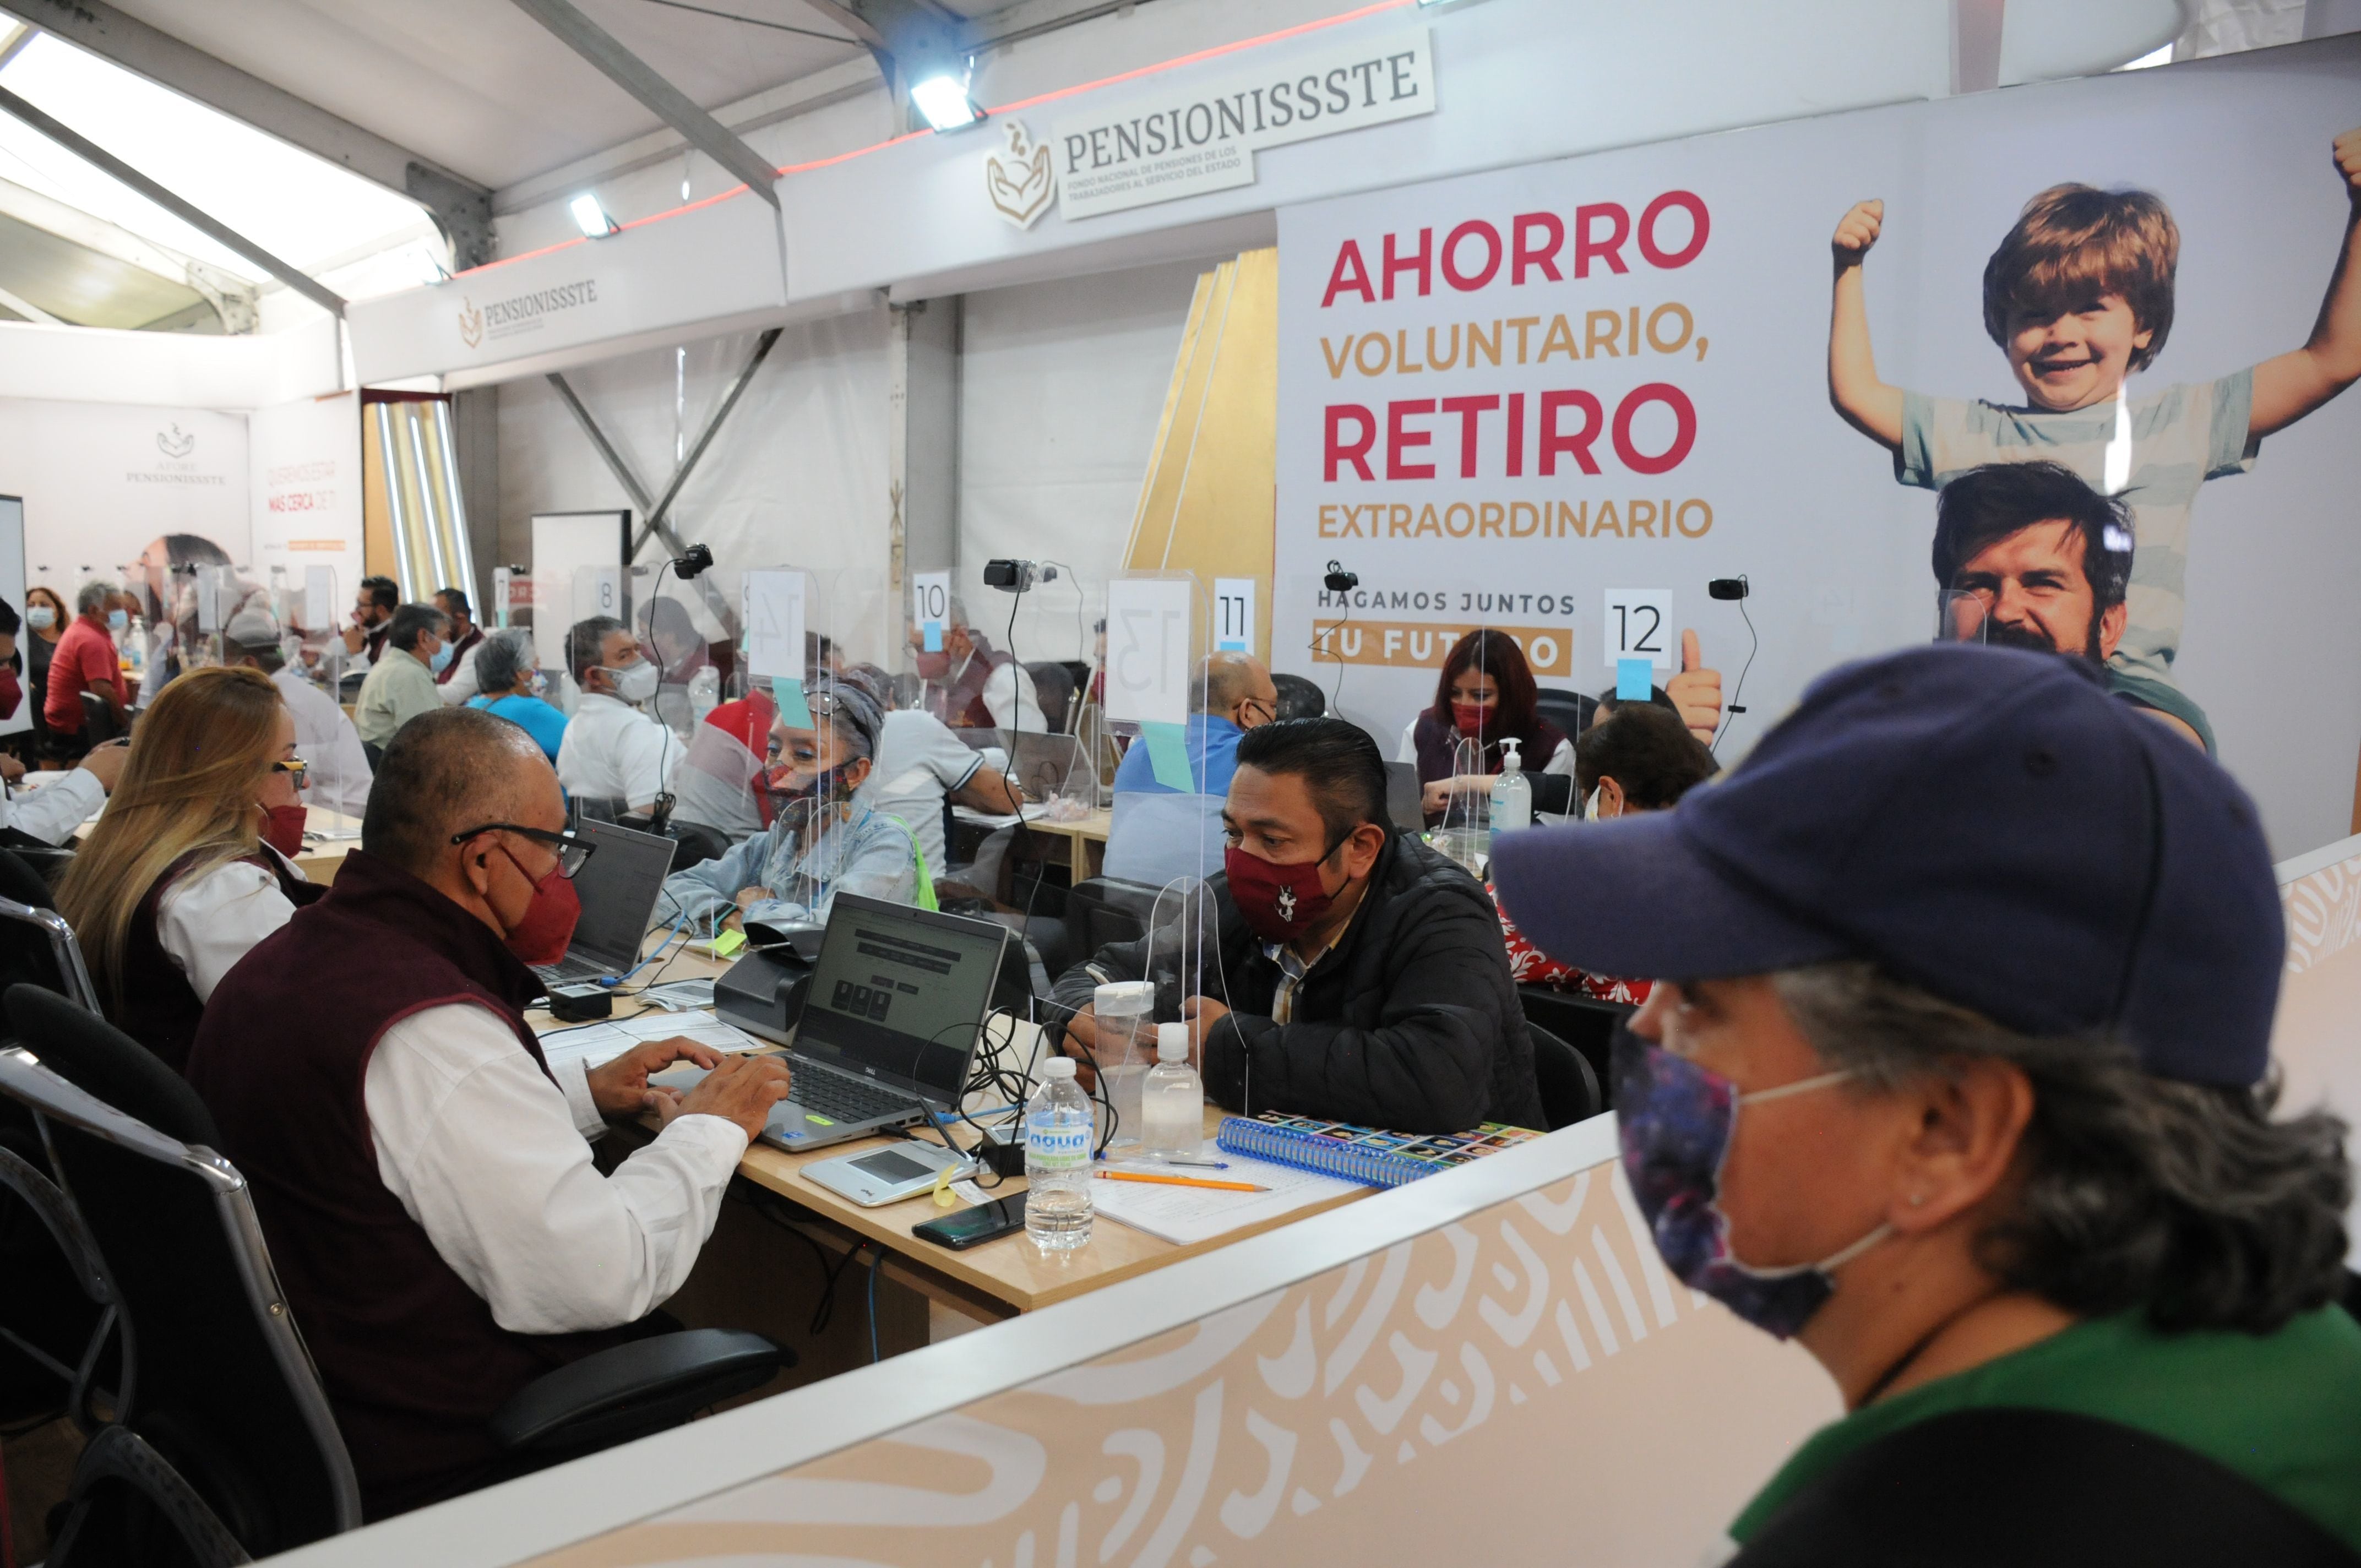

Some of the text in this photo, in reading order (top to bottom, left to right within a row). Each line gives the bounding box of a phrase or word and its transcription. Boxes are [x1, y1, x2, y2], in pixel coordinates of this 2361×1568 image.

[1064, 51, 1418, 174] PENSIONISSSTE
[1068, 146, 1237, 190] FONDO NACIONAL DE PENSIONES DE LOS
[1069, 158, 1241, 202] TRABAJADORES AL SERVICIO DEL ESTADO
[1320, 190, 1710, 308] AHORRO
[485, 279, 597, 327] PENSIONISSSTE
[1320, 302, 1709, 379] VOLUNTARIO,
[1323, 382, 1697, 482] RETIRO
[126, 472, 226, 485] PENSIONISSSTE
[287, 492, 314, 511] CERCA
[1318, 498, 1713, 539] EXTRAORDINARIO
[602, 582, 612, 608] 8
[917, 585, 945, 618] 10
[1318, 590, 1574, 615] HAGAMOS JUNTOS
[1219, 596, 1244, 636] 11
[1612, 605, 1663, 654] 12
[1316, 627, 1558, 668] TU FUTO
[1030, 1134, 1084, 1153] agua
